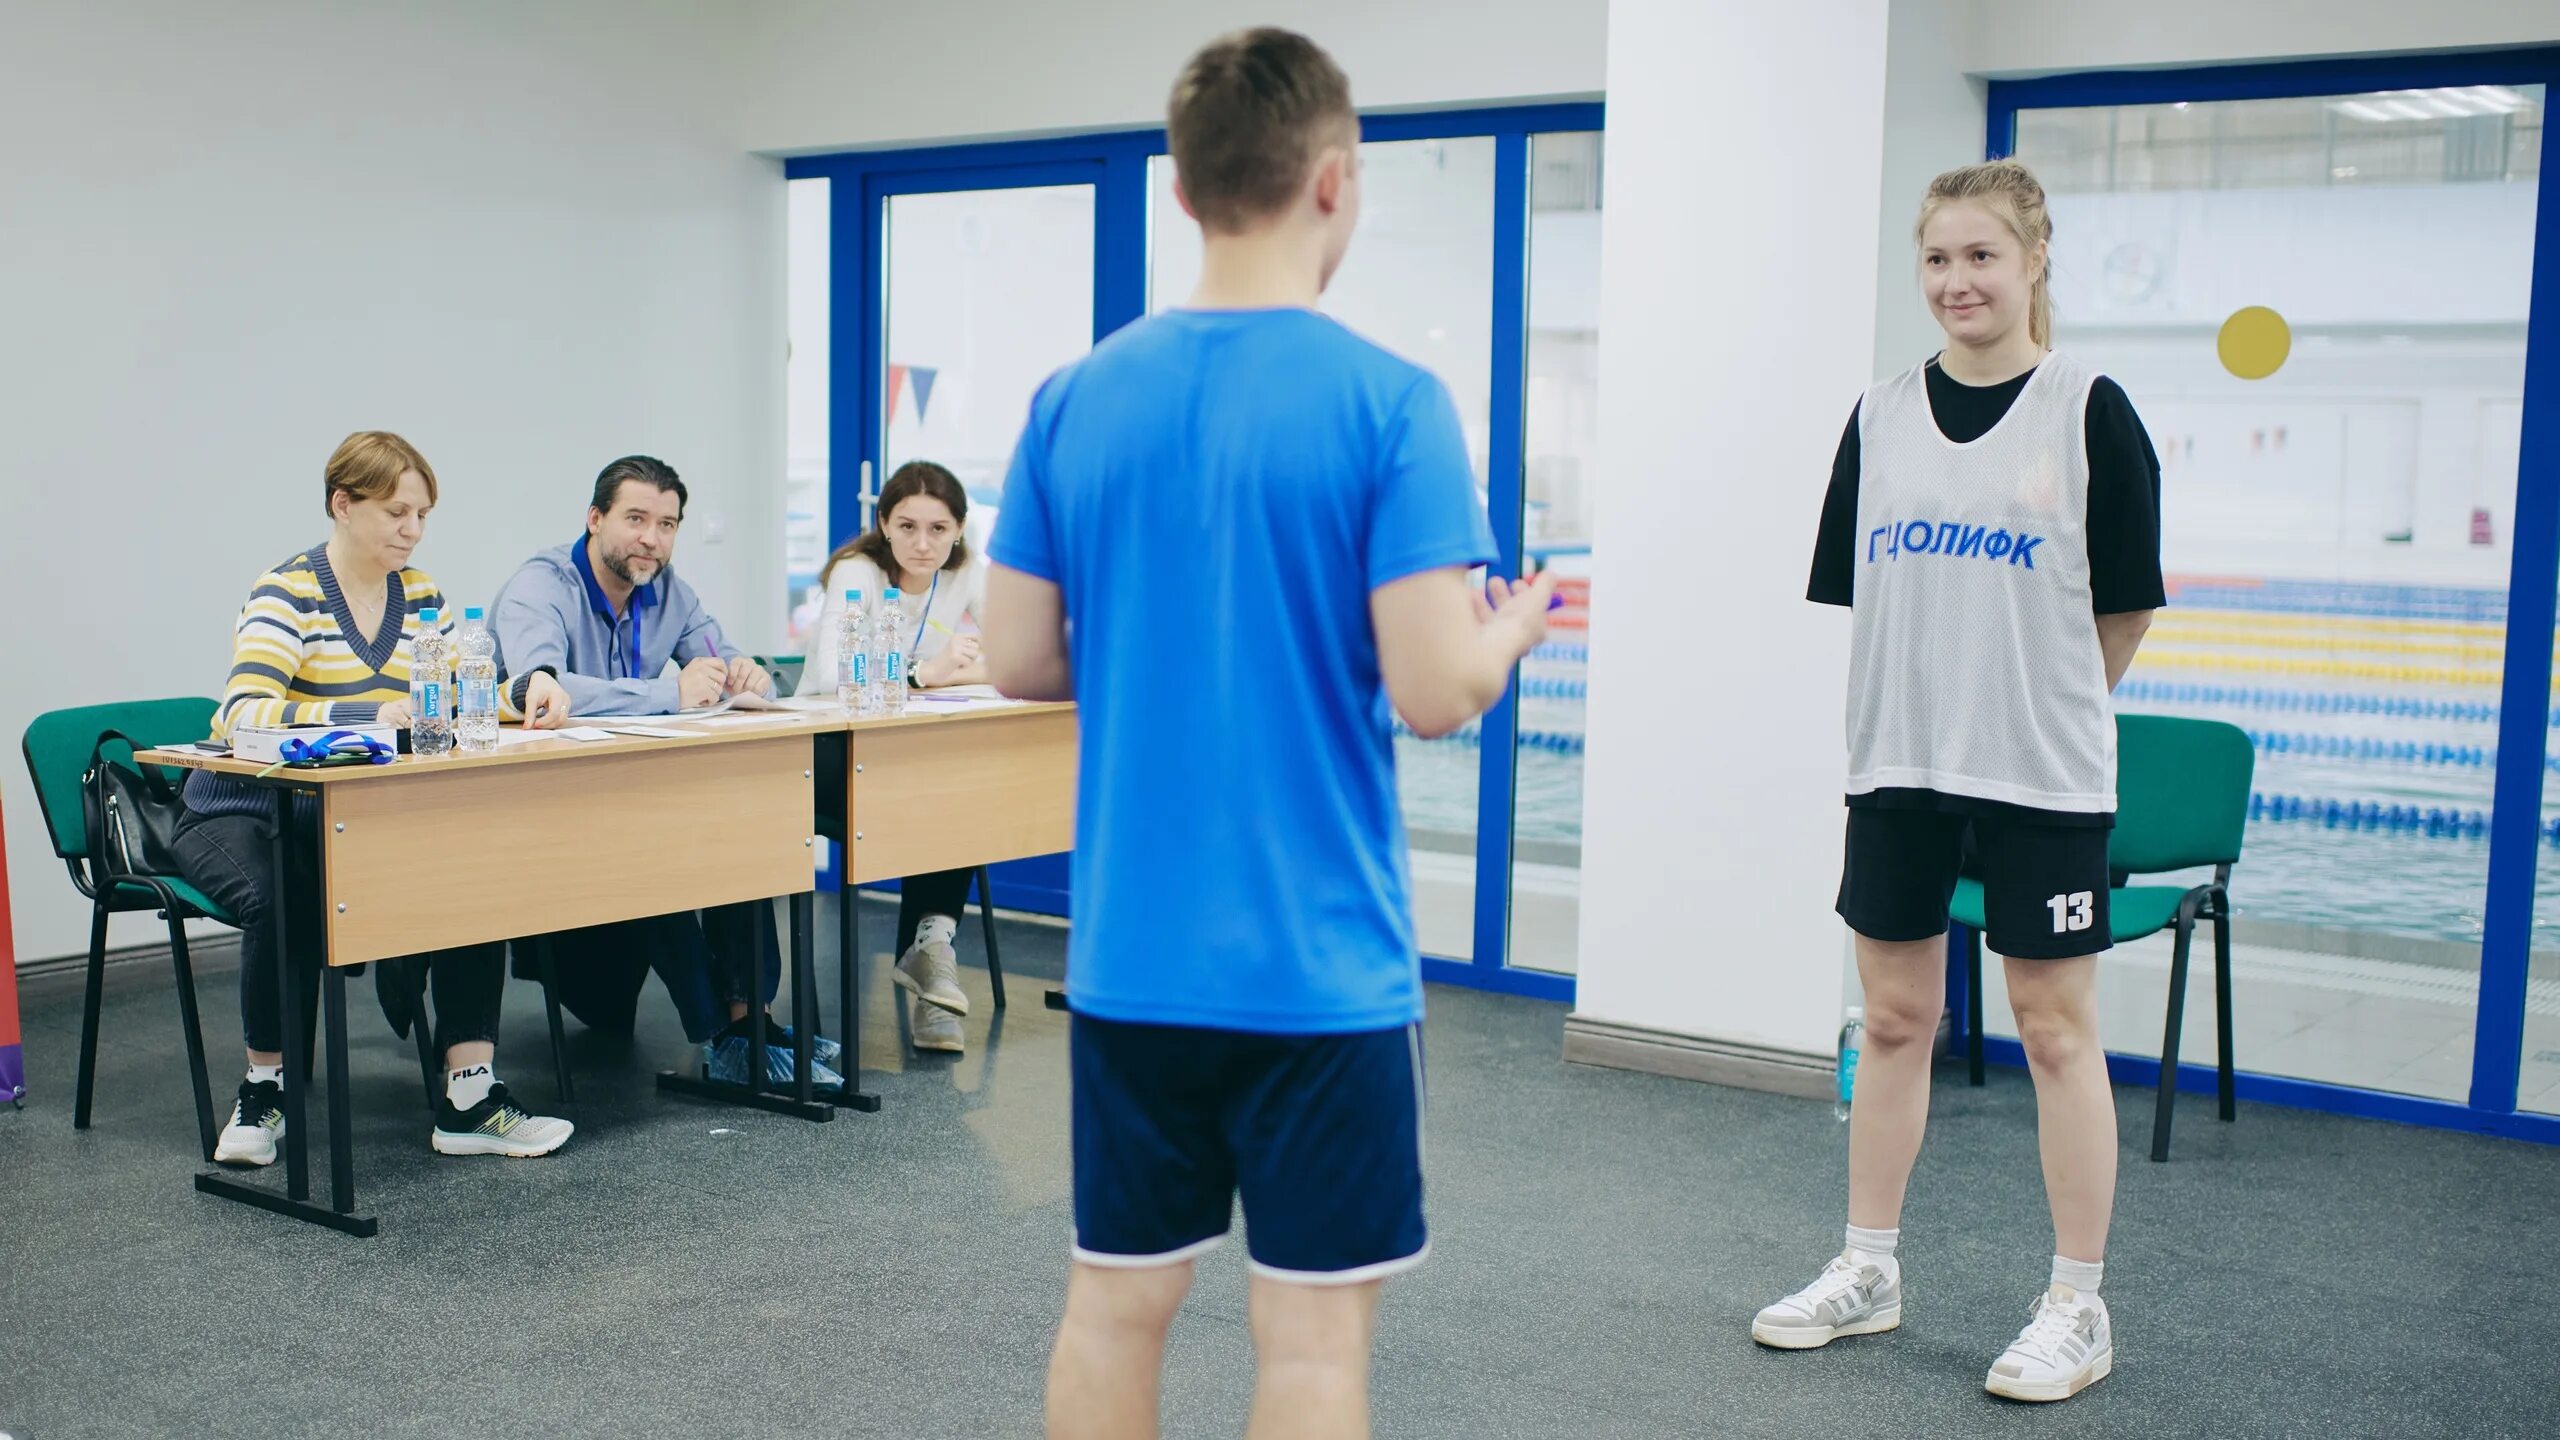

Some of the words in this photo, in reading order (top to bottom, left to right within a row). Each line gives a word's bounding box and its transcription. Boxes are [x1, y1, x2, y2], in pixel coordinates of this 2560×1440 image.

[1867, 519, 2046, 571] ГЦОЛИФК
[426, 685, 438, 716] Vorgol
[2046, 890, 2093, 933] 13
[452, 1066, 489, 1081] FILA
